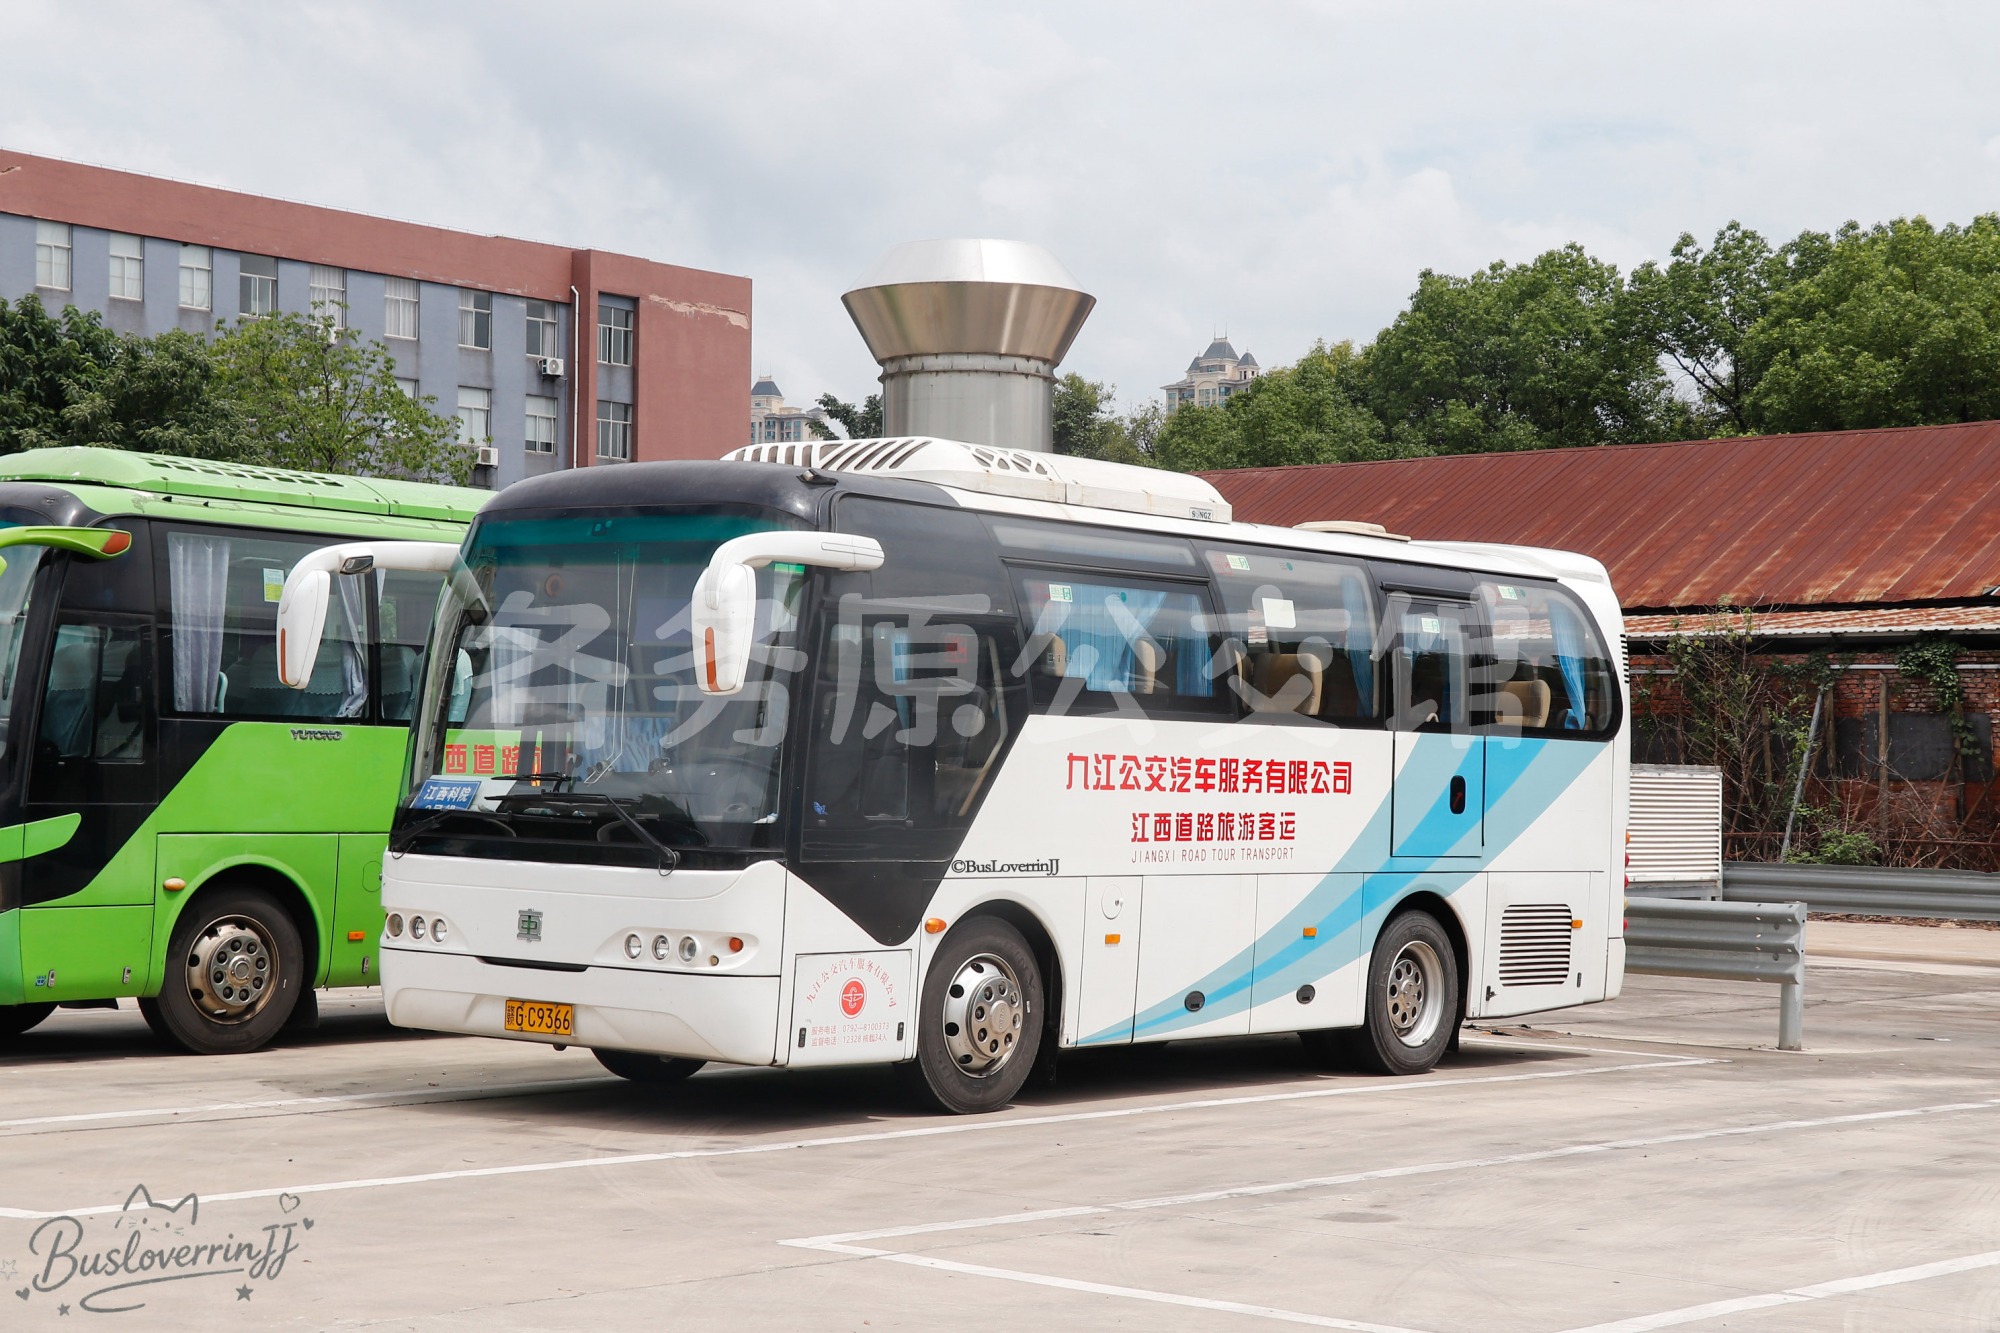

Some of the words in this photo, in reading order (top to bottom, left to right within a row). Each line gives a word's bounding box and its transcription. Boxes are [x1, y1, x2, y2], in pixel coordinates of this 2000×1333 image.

[290, 729, 343, 741] YUTONG
[1065, 752, 1353, 796] 九江公交汽车服务有限公司
[423, 785, 472, 803] 江西科院
[1130, 811, 1297, 843] 江西道路旅游客运
[1131, 850, 1175, 864] JIANGXI
[1181, 849, 1207, 862] ROAD
[1212, 848, 1236, 861] TOUR
[1241, 847, 1294, 861] TRANSPORT
